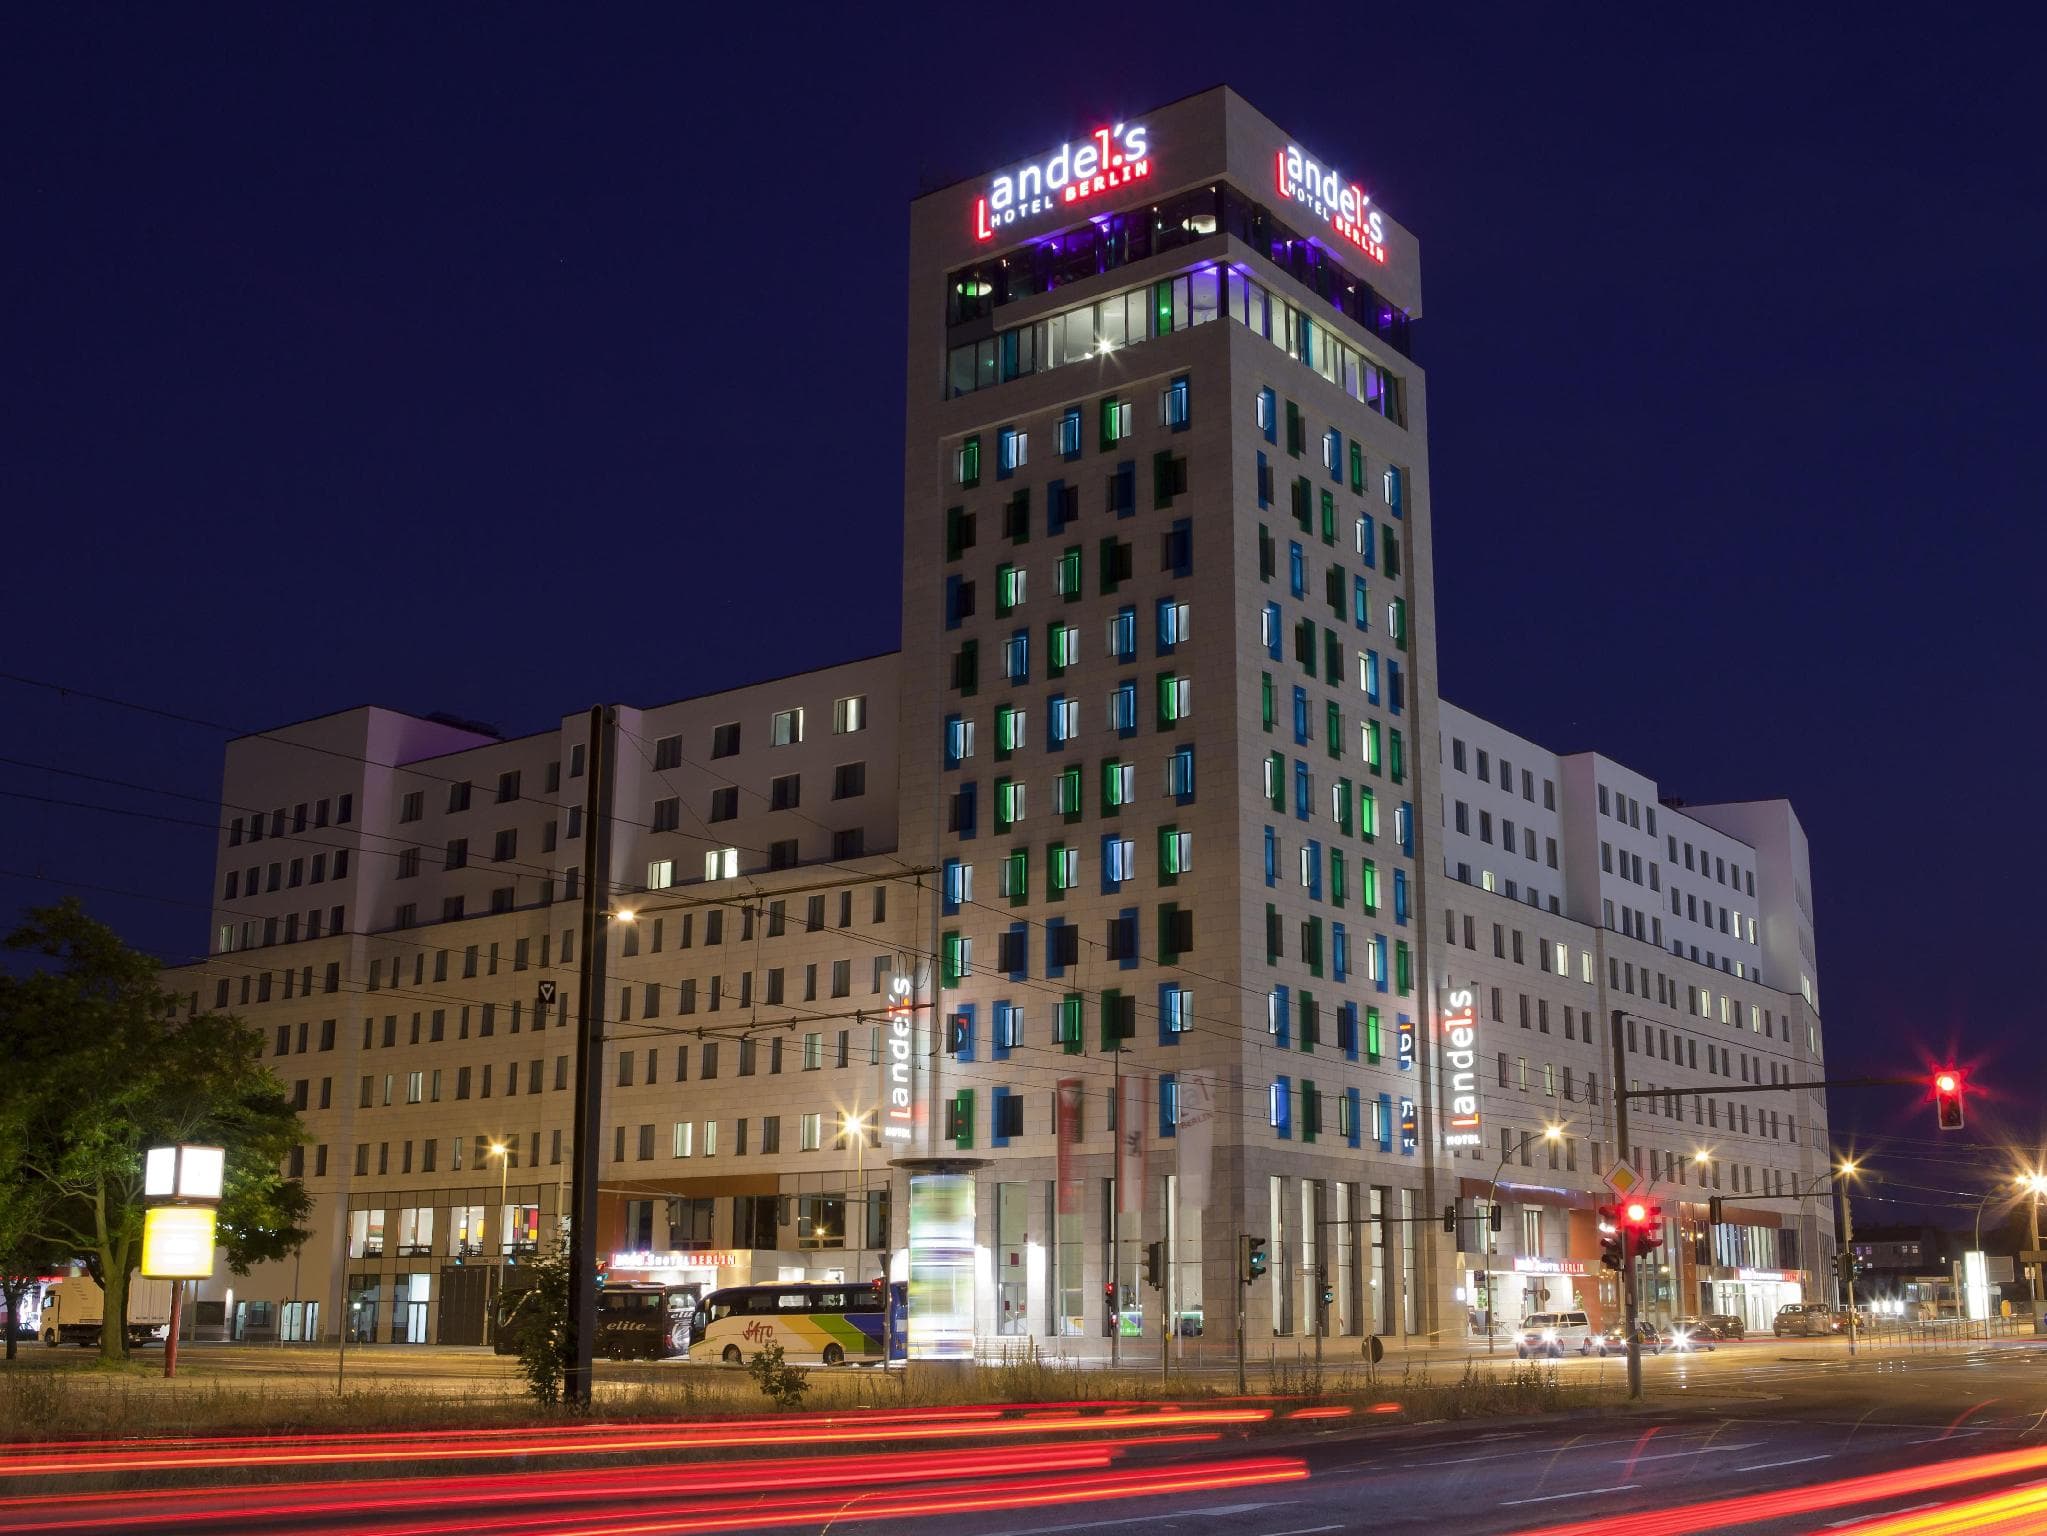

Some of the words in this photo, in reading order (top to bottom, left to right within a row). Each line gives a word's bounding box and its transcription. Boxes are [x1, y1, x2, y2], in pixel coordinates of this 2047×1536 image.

[991, 195, 1053, 228] HOTEL
[1064, 159, 1149, 202] BERLIN
[1288, 180, 1330, 222] HOTEL
[1335, 214, 1384, 263] BERLIN
[1446, 1134, 1481, 1147] HOTEL
[691, 1255, 736, 1266] BERLIN
[606, 1320, 646, 1331] elite
